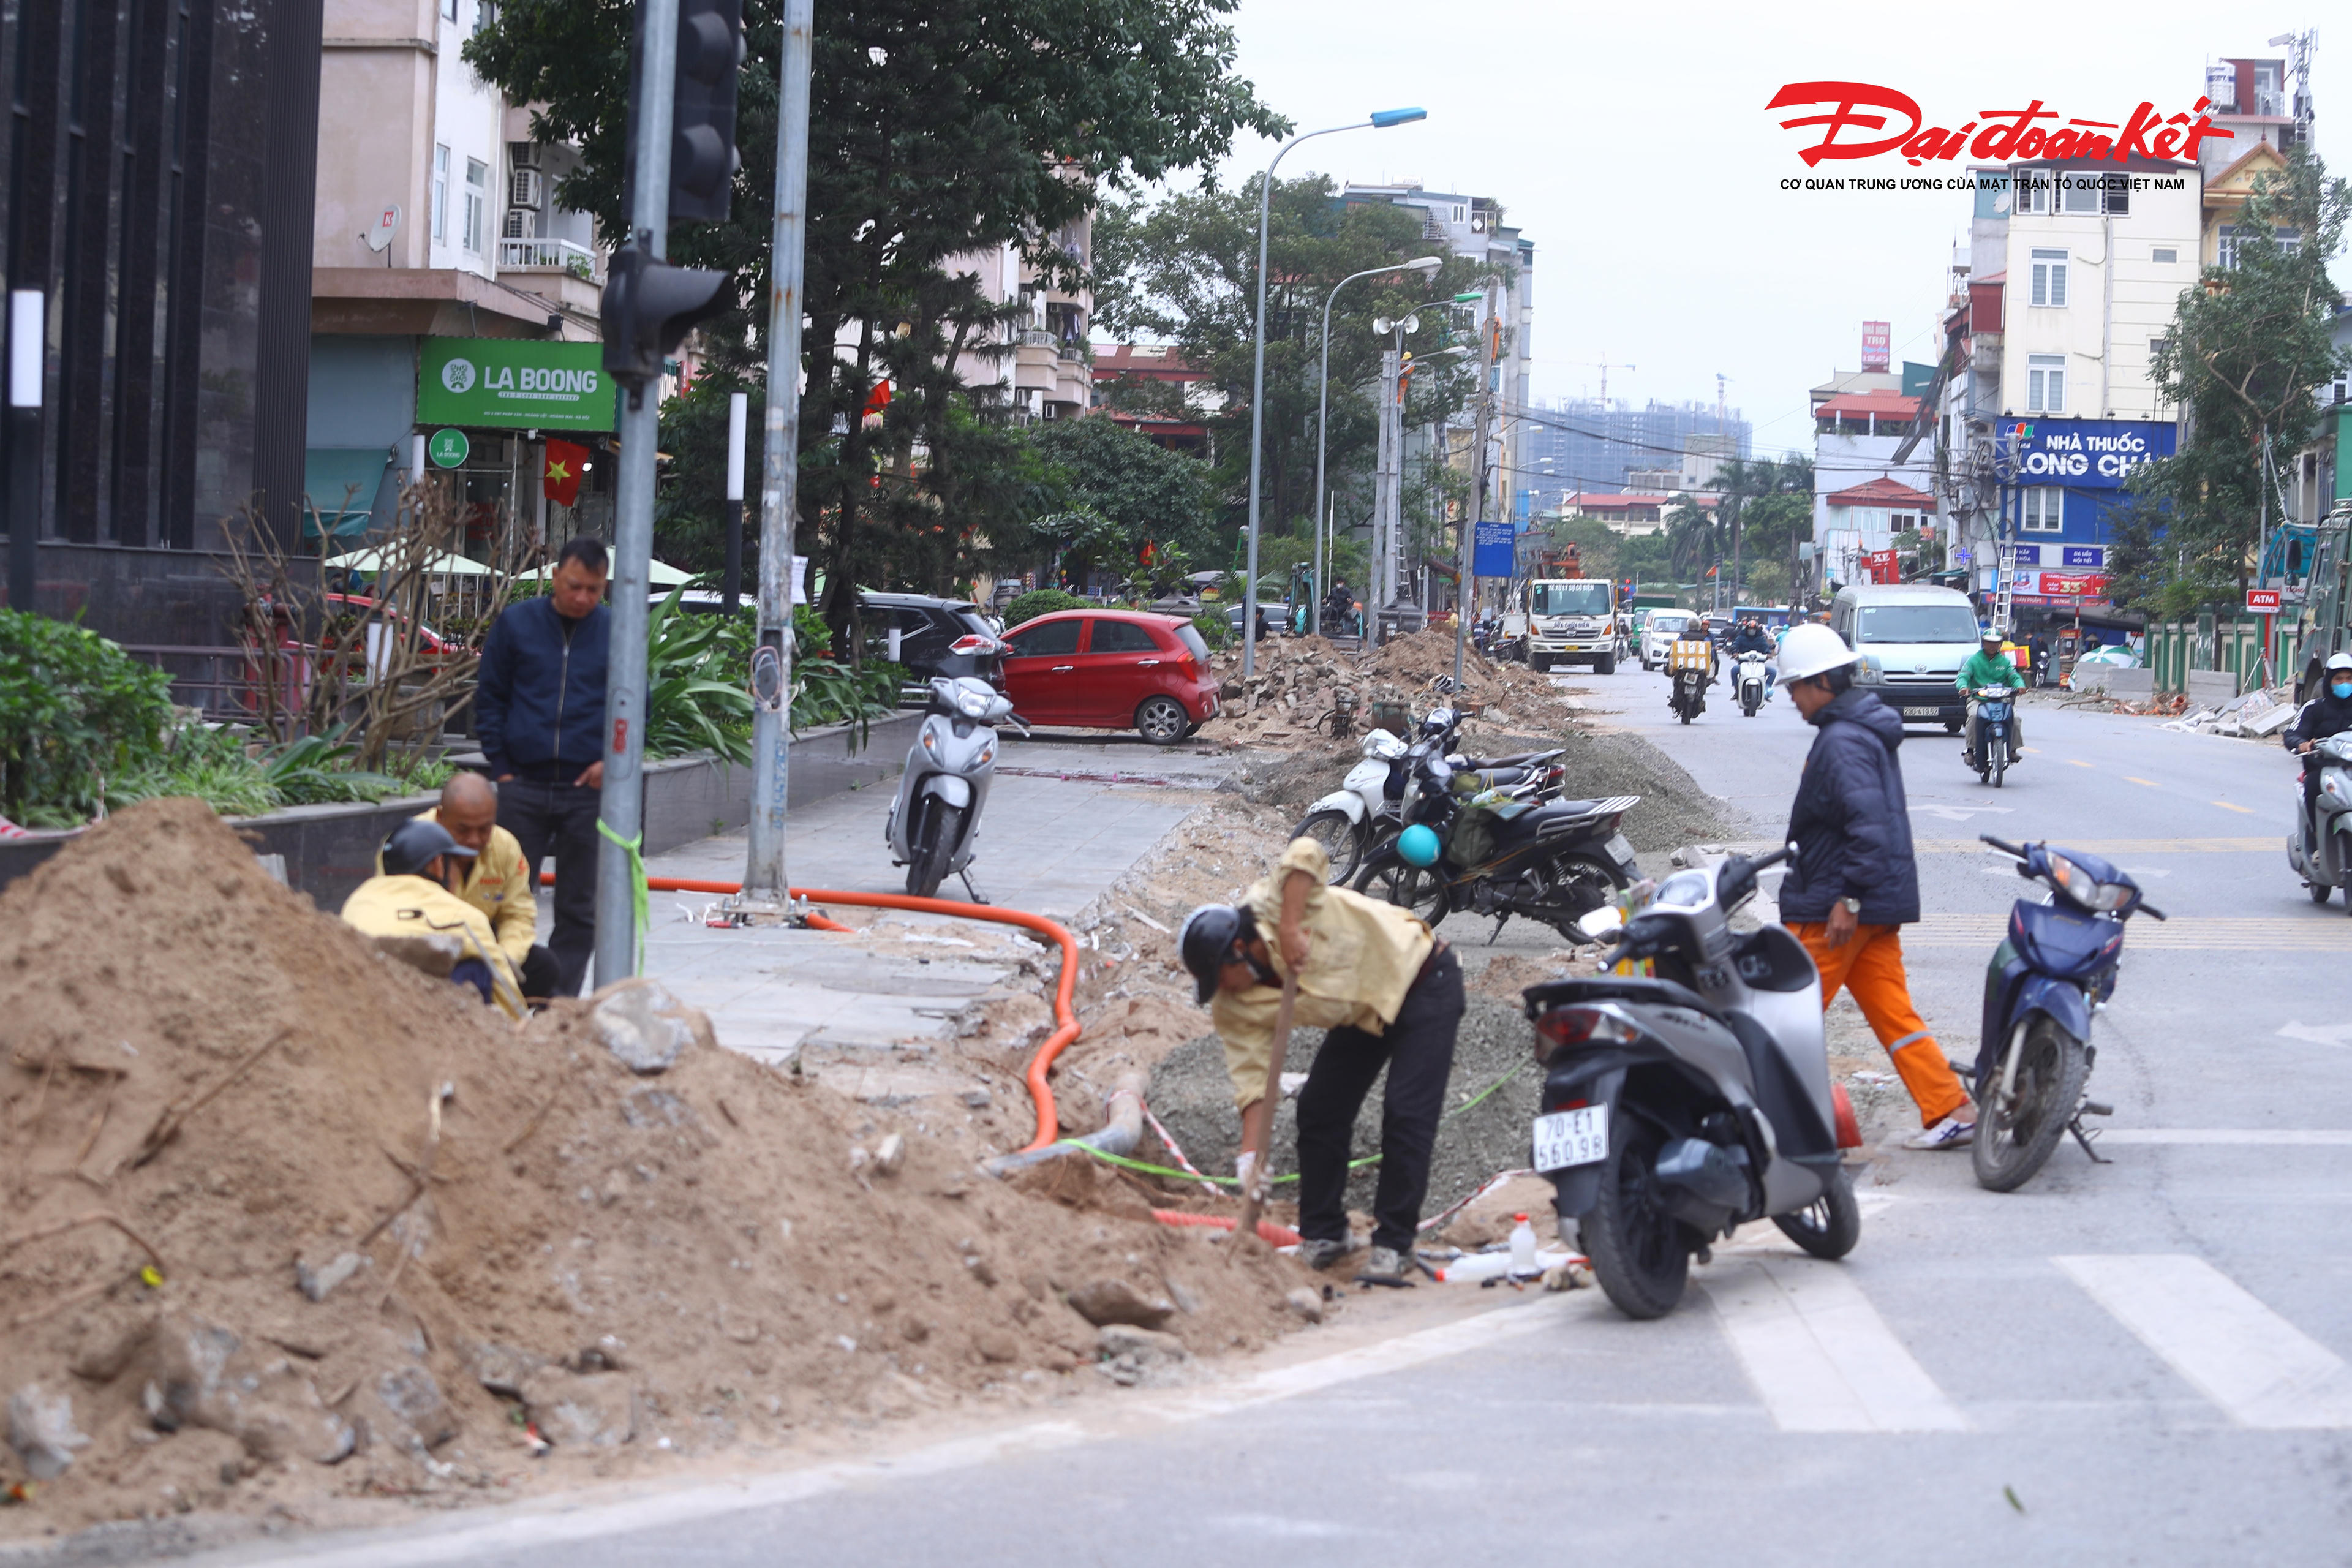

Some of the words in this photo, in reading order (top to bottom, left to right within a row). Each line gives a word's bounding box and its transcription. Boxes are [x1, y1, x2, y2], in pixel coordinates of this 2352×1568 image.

[484, 366, 514, 390] LA
[520, 368, 597, 393] BOONG
[2046, 431, 2082, 451] NHÀ
[2086, 431, 2146, 453] THUỐC
[1873, 552, 1890, 563] XE
[2253, 594, 2275, 604] ATM
